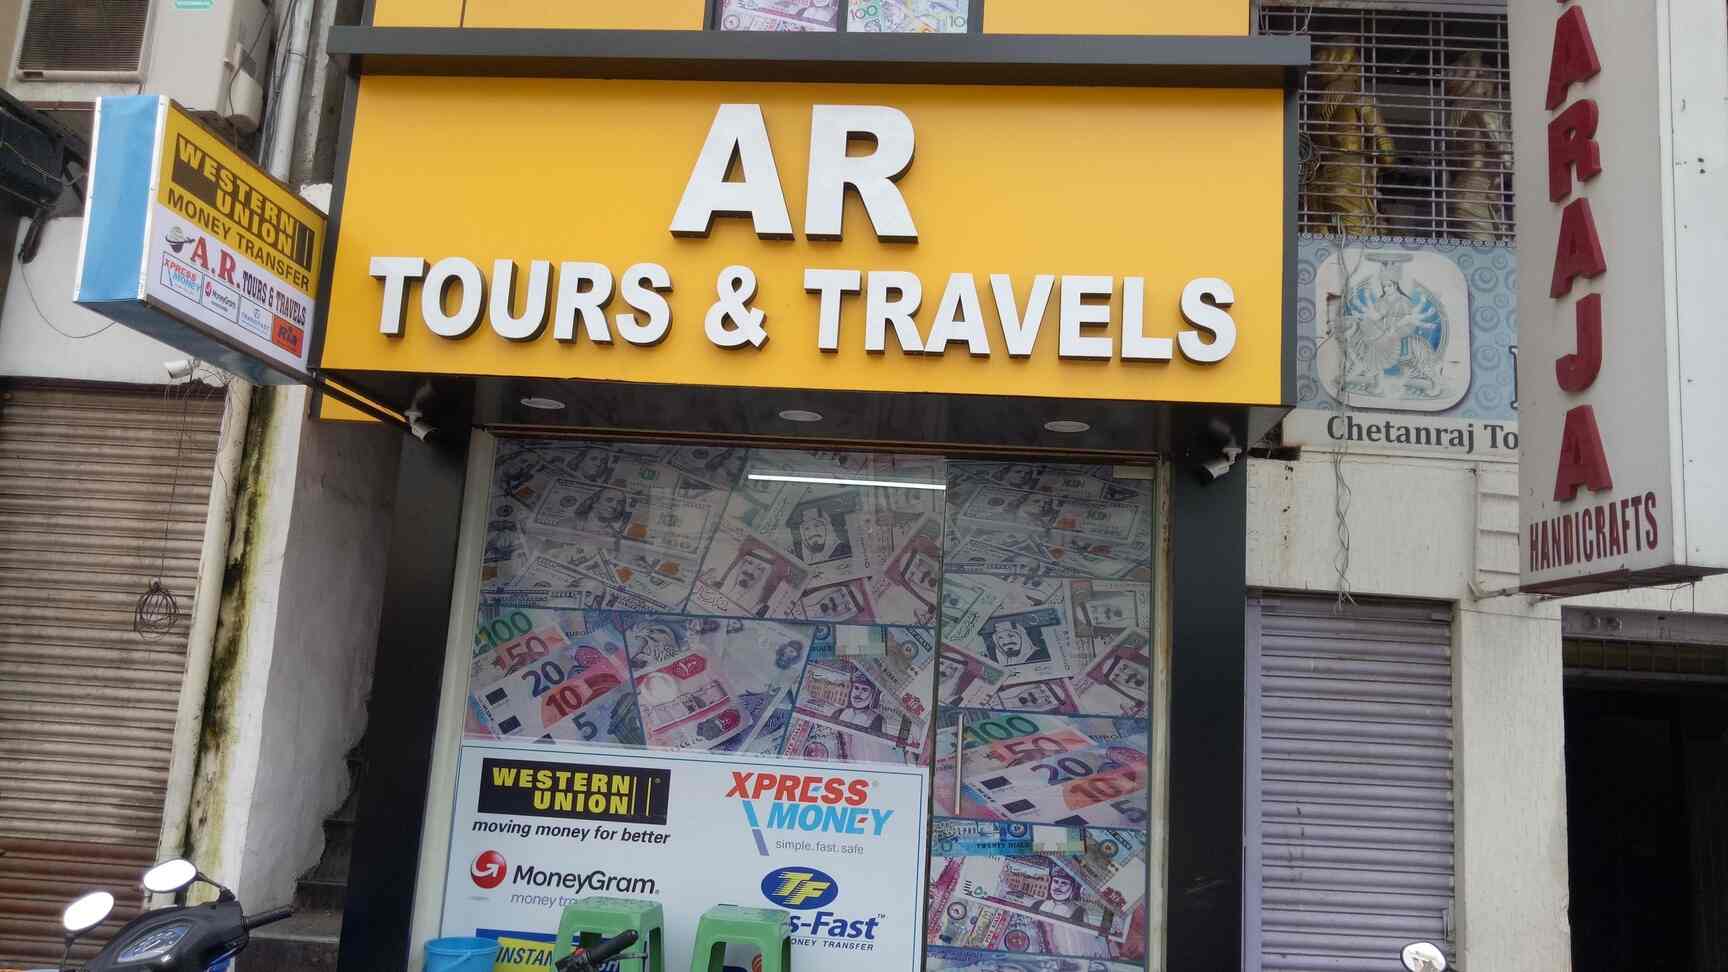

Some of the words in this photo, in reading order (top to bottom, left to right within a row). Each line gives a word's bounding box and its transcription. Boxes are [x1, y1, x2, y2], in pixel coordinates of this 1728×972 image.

[178, 137, 295, 236] WESTERN
[669, 104, 918, 243] AR
[168, 187, 231, 241] MONEY
[236, 232, 310, 292] TRANSFER
[215, 189, 293, 257] UNION
[1546, 0, 1613, 502] ARAJA
[190, 236, 240, 288] A.R.
[242, 271, 268, 304] TOURS
[269, 287, 274, 307] &
[276, 290, 307, 326] TRAVELS
[369, 256, 672, 348] TOURS
[704, 264, 769, 351] &
[804, 268, 1237, 364] TRAVELS
[1327, 415, 1475, 454] Chetanraj
[1484, 424, 1519, 450] To
[1529, 491, 1659, 572] HANDICRAFTS
[521, 661, 565, 697] 20
[547, 686, 582, 717] 10
[572, 712, 598, 741] 5
[492, 767, 630, 794] WESTERN
[725, 771, 870, 805] XPRESS
[1030, 757, 1094, 786] 20
[533, 790, 629, 815] UNION
[767, 801, 894, 836] MONEY
[472, 819, 534, 838] moving
[535, 823, 590, 842] money
[594, 826, 618, 841] for
[621, 828, 671, 844] better
[512, 865, 656, 894] MoneyGram
[510, 894, 557, 908] money
[790, 911, 879, 940] s-Fast
[496, 947, 556, 967] INSTAN
[791, 937, 817, 946] ONEY
[823, 940, 874, 951] TRANSFER
